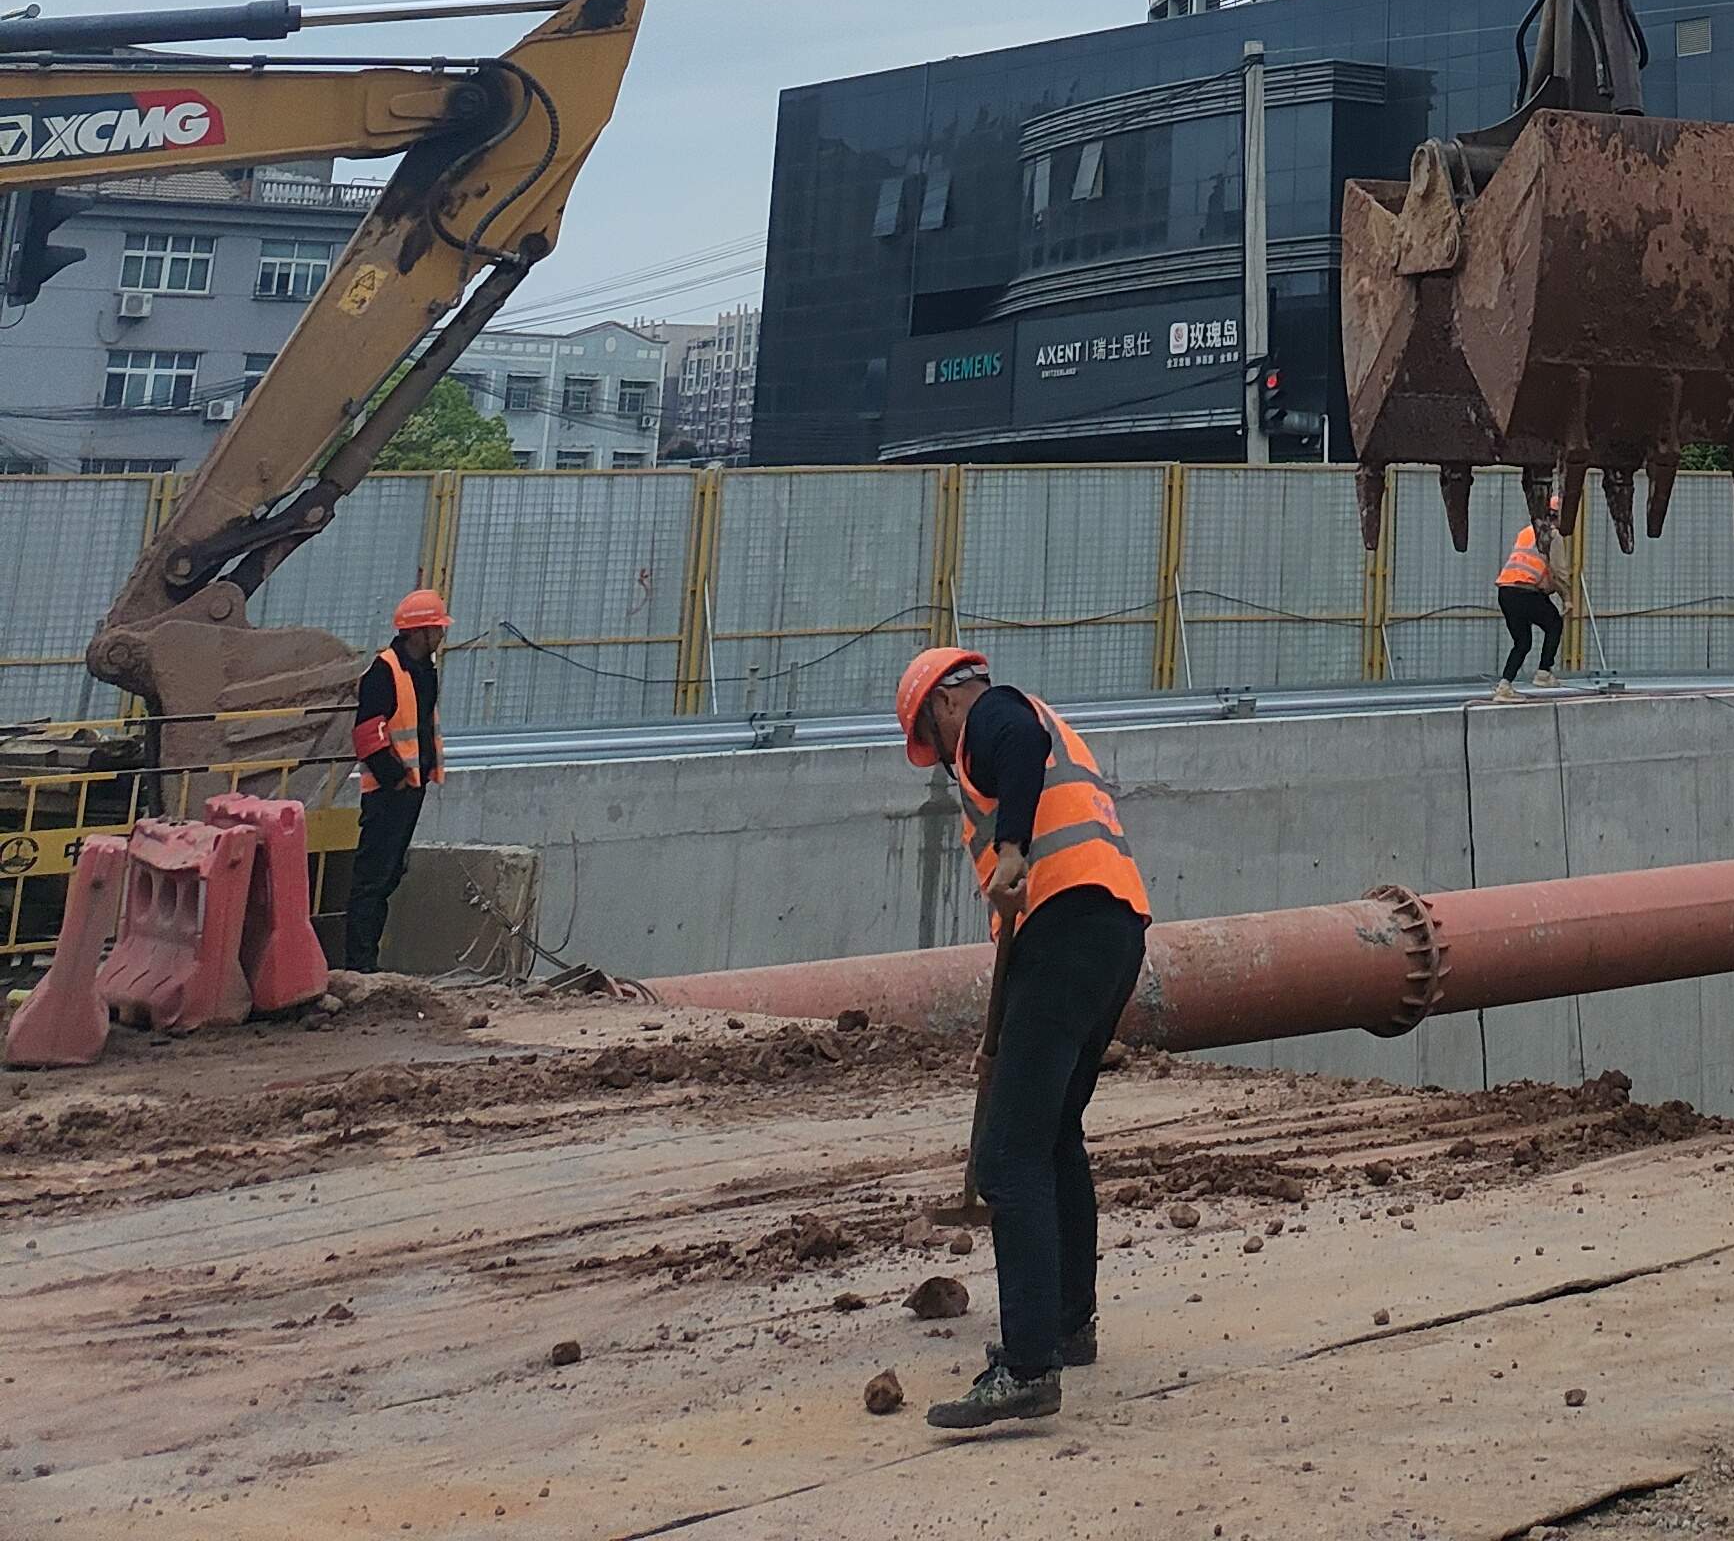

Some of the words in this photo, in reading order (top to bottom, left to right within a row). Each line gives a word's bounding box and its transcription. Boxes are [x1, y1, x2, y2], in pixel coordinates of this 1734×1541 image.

[31, 102, 210, 160] XCMG
[1036, 342, 1082, 366] AXENT
[1092, 331, 1151, 361] 瑞士恩仕
[1189, 319, 1238, 349] 玫瑰岛
[939, 352, 1002, 382] SIEMENS
